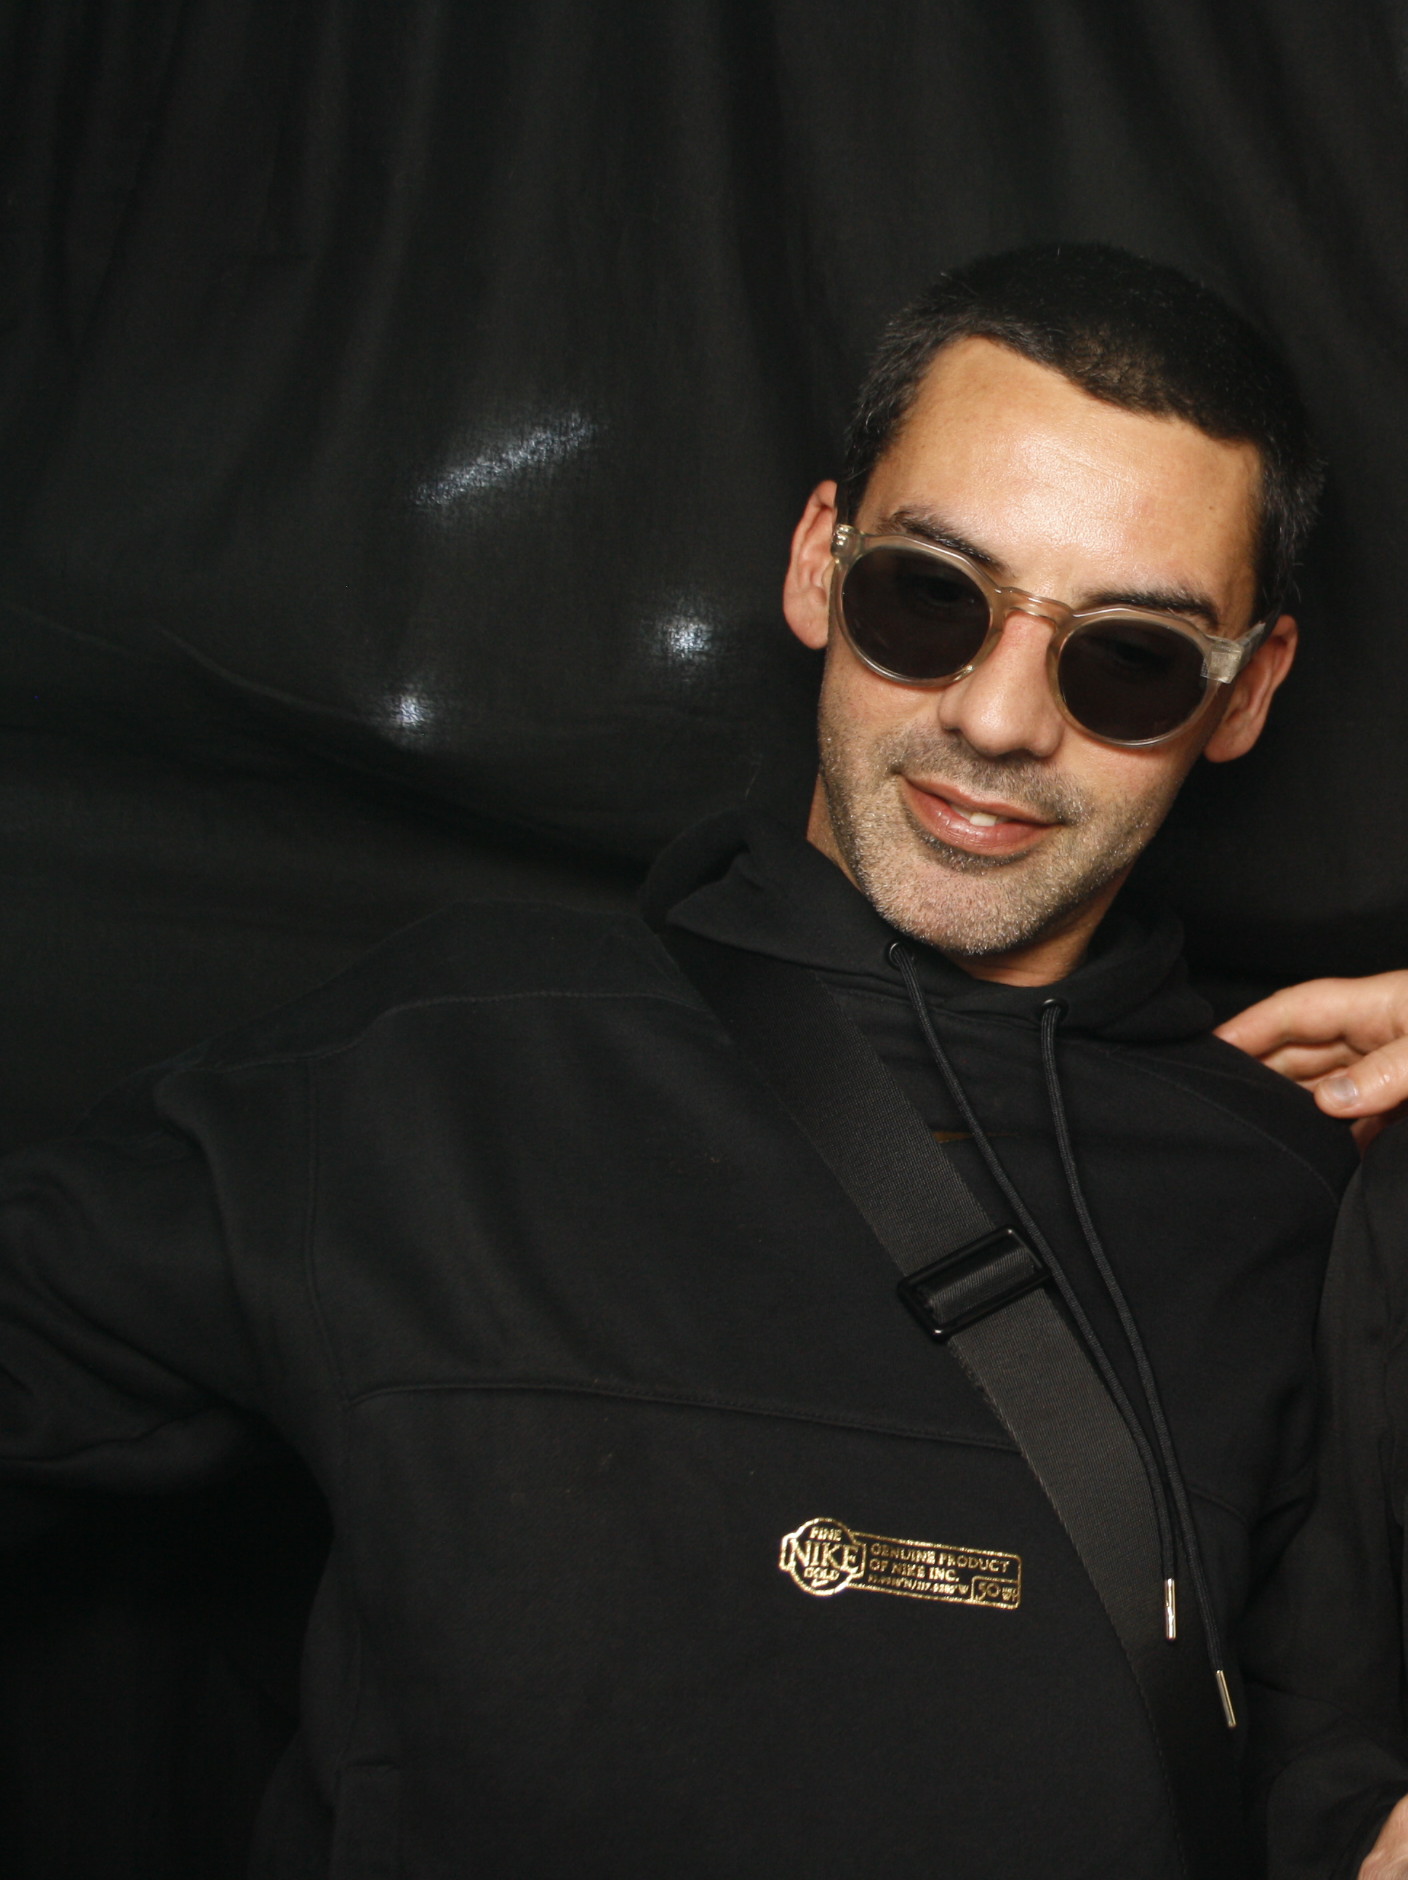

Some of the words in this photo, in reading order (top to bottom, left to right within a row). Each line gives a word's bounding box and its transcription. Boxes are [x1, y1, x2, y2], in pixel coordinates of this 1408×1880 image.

[809, 1526, 842, 1541] FINE
[789, 1538, 859, 1574] NIKE
[870, 1542, 936, 1564] GENUINE
[938, 1552, 1010, 1573] PRODUCT
[803, 1566, 840, 1581] GOLD
[869, 1558, 889, 1573] OF
[891, 1562, 926, 1579] NIKE
[928, 1566, 960, 1583] INC.
